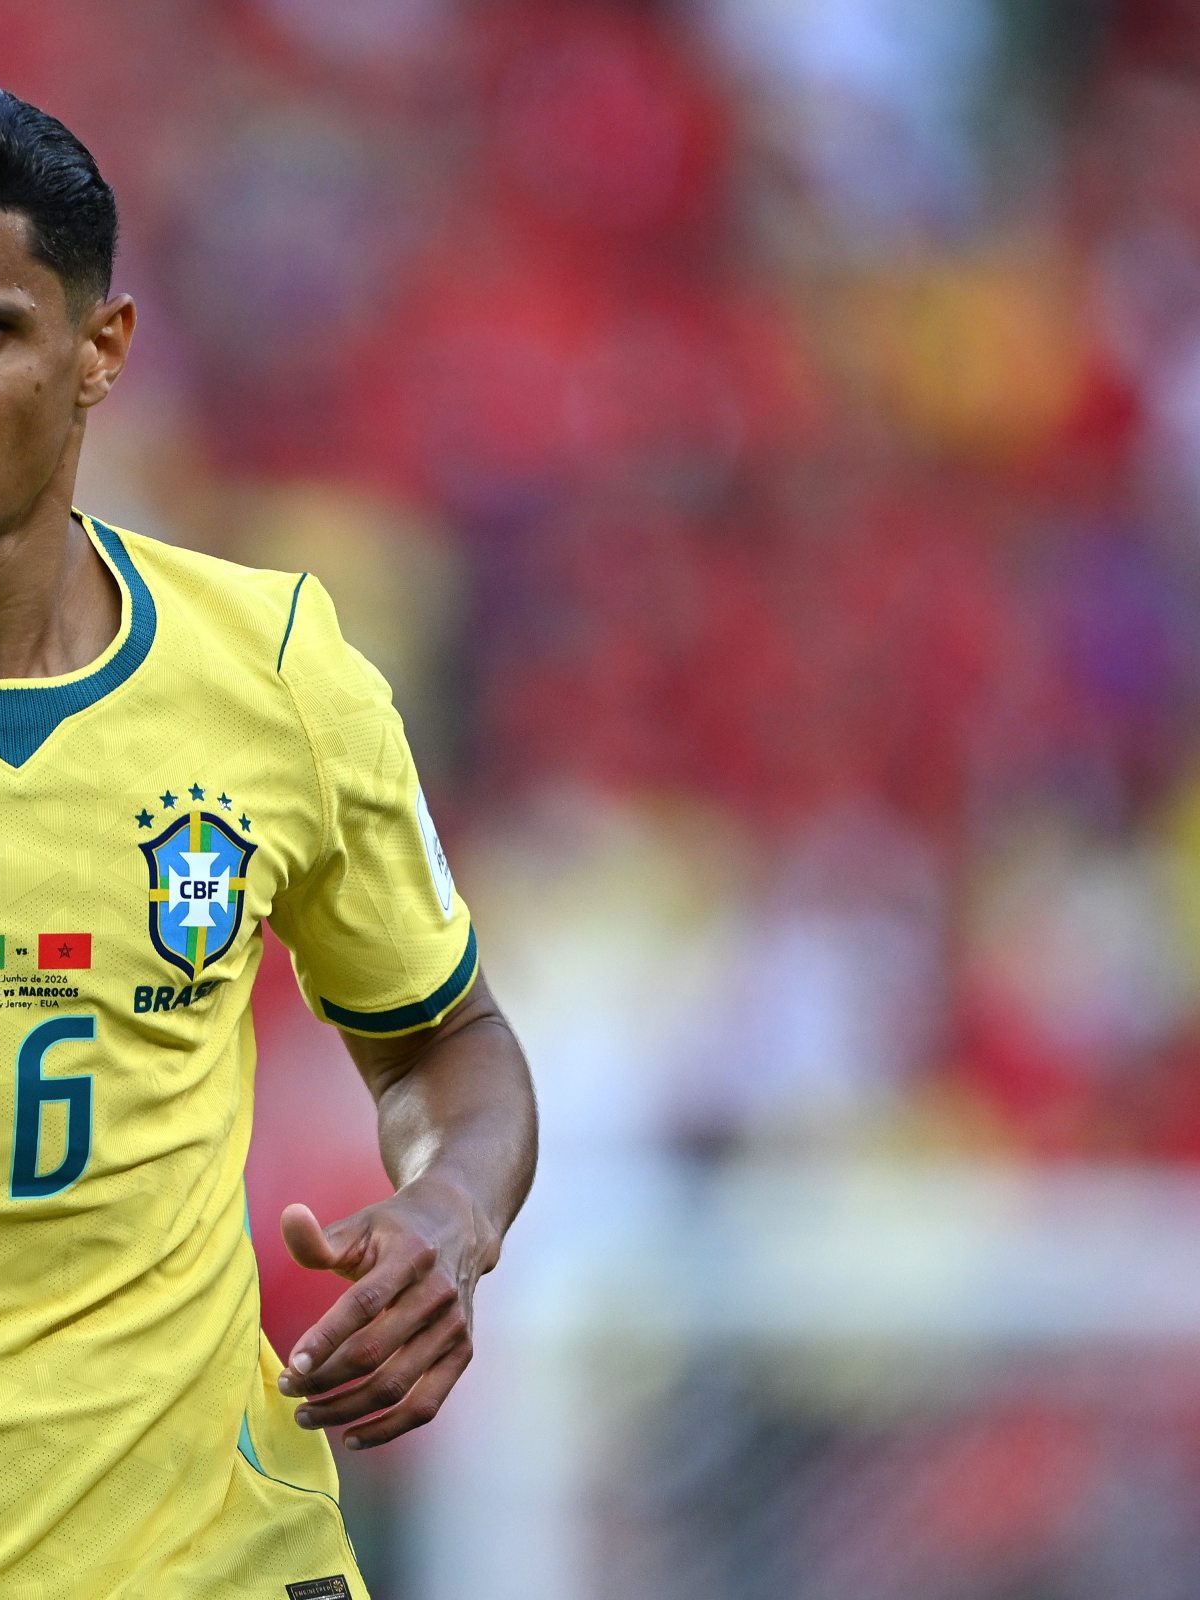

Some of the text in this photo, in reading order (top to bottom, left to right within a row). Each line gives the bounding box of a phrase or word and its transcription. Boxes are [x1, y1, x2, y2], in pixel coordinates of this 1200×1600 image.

[179, 880, 219, 900] CBF
[15, 947, 28, 956] vs
[1, 974, 28, 983] Junho
[30, 975, 42, 983] de
[44, 975, 68, 984] 2026
[3, 988, 15, 997] vs
[18, 986, 79, 998] MARROCOS
[5, 1000, 32, 1010] Jersey
[40, 1000, 59, 1008] EUA
